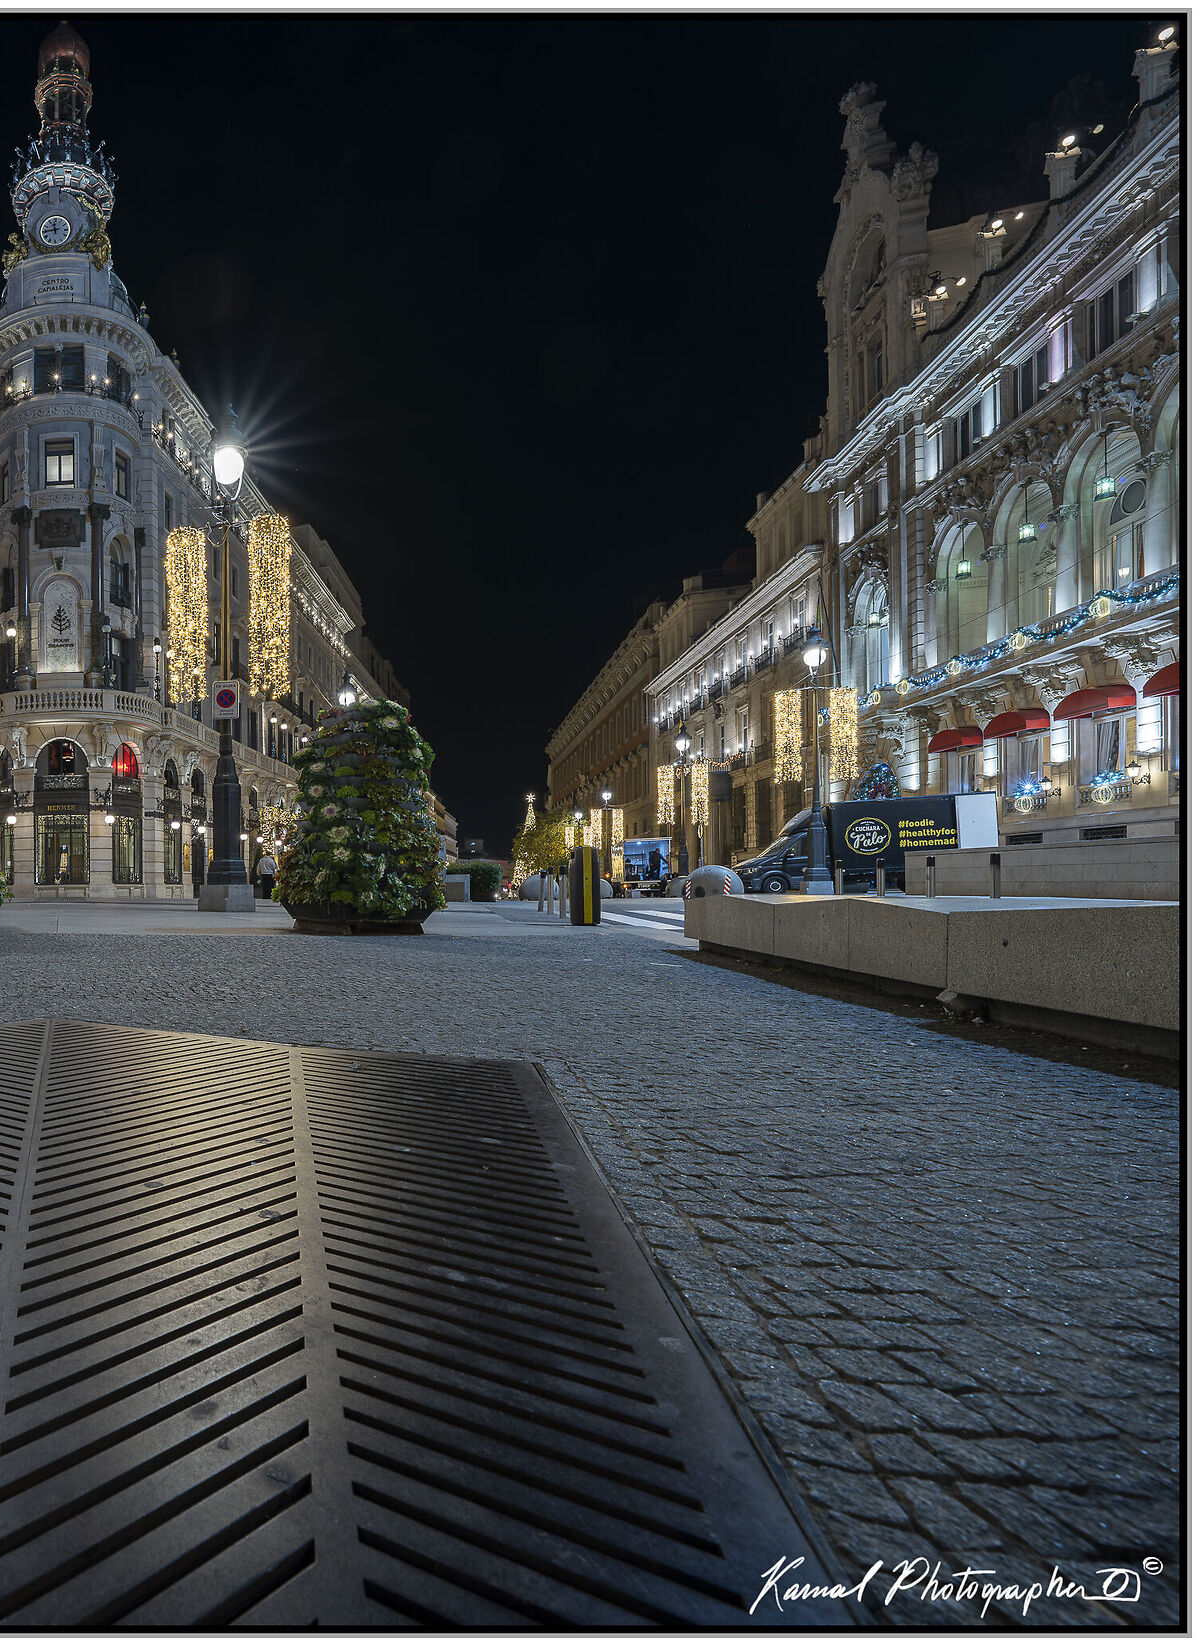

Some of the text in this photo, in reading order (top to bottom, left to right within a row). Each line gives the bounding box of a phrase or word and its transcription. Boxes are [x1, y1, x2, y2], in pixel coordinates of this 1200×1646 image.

[41, 278, 70, 286] CENTRO
[37, 285, 74, 293] CANALEJAS
[898, 818, 935, 828] #foodie
[898, 827, 956, 837] #healthyfoo
[850, 831, 887, 849] Palo
